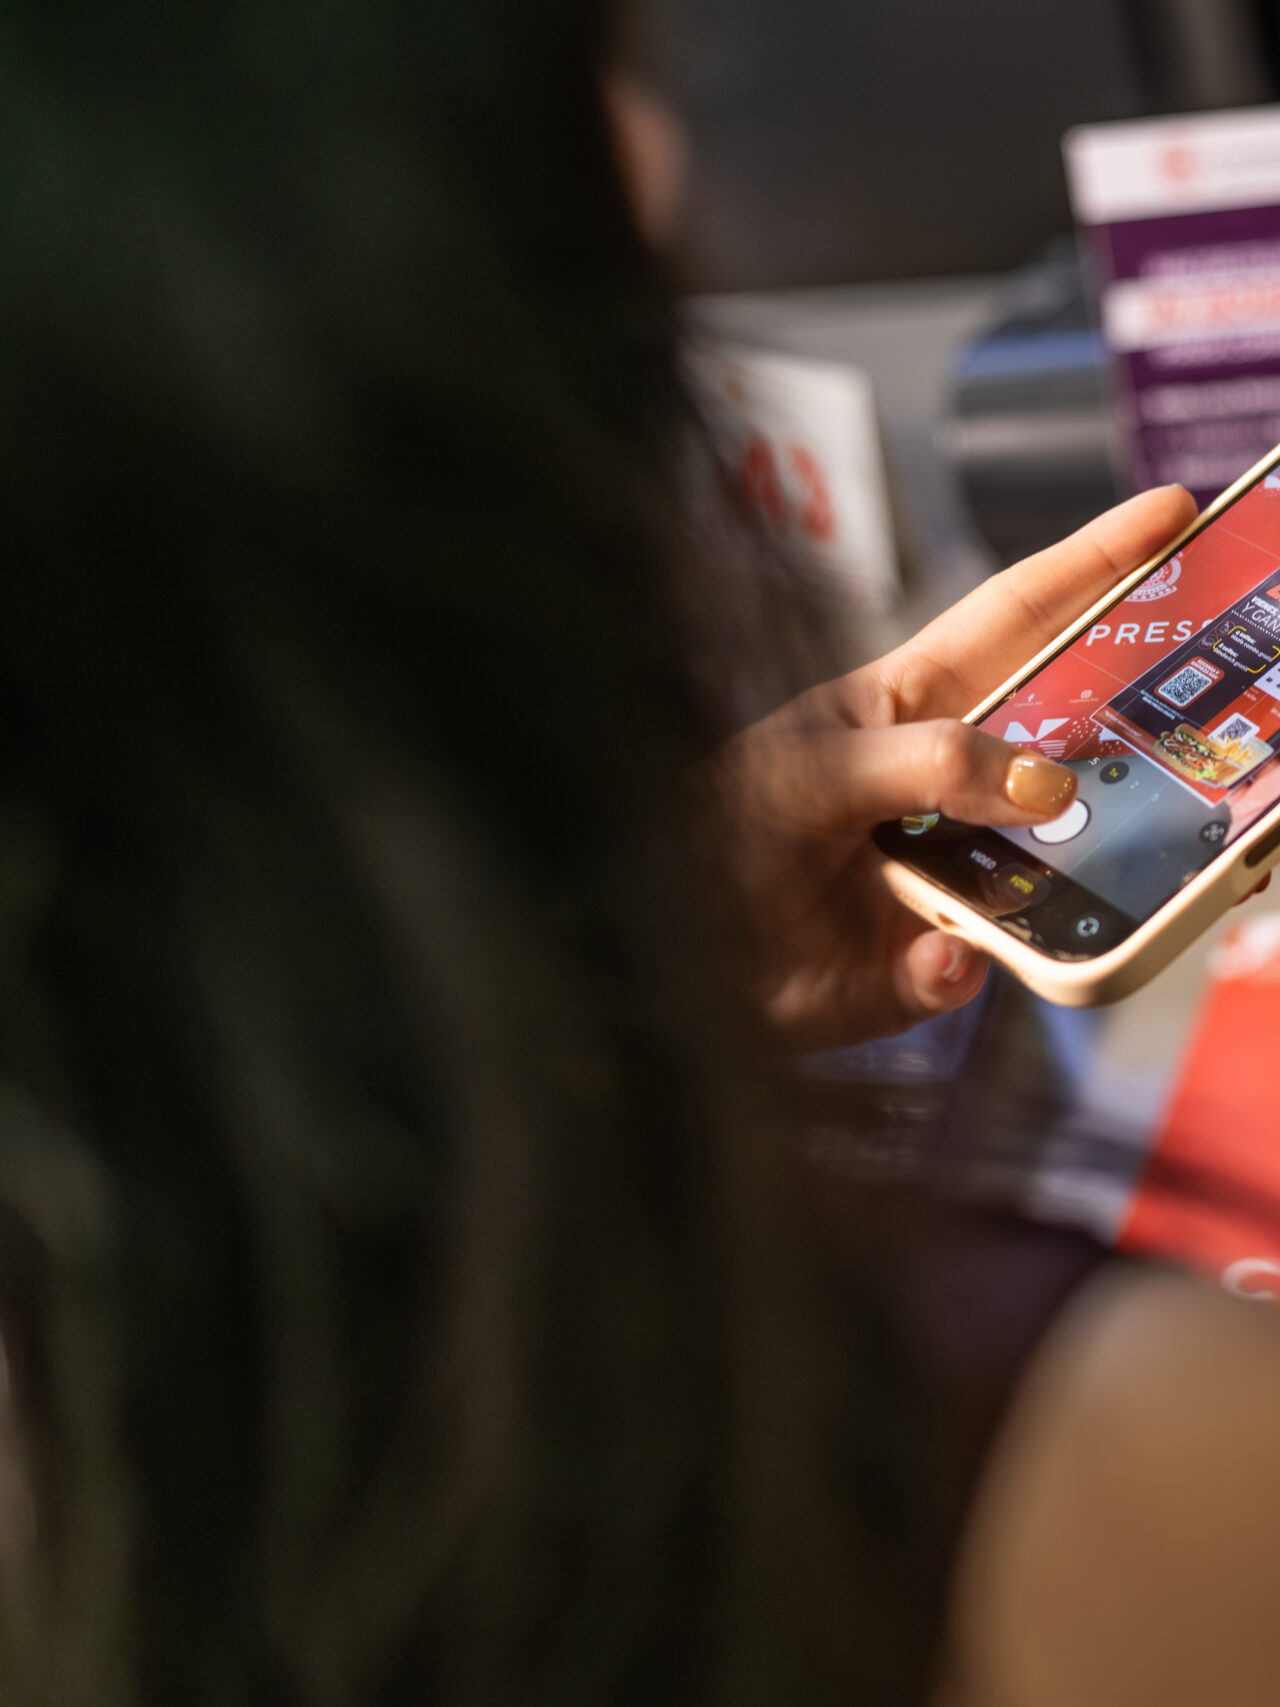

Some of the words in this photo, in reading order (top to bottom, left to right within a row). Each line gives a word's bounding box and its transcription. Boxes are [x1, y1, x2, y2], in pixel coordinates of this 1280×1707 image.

[1241, 602, 1251, 614] Y
[970, 849, 997, 870] VIDEO
[1009, 875, 1034, 895] FOTO
